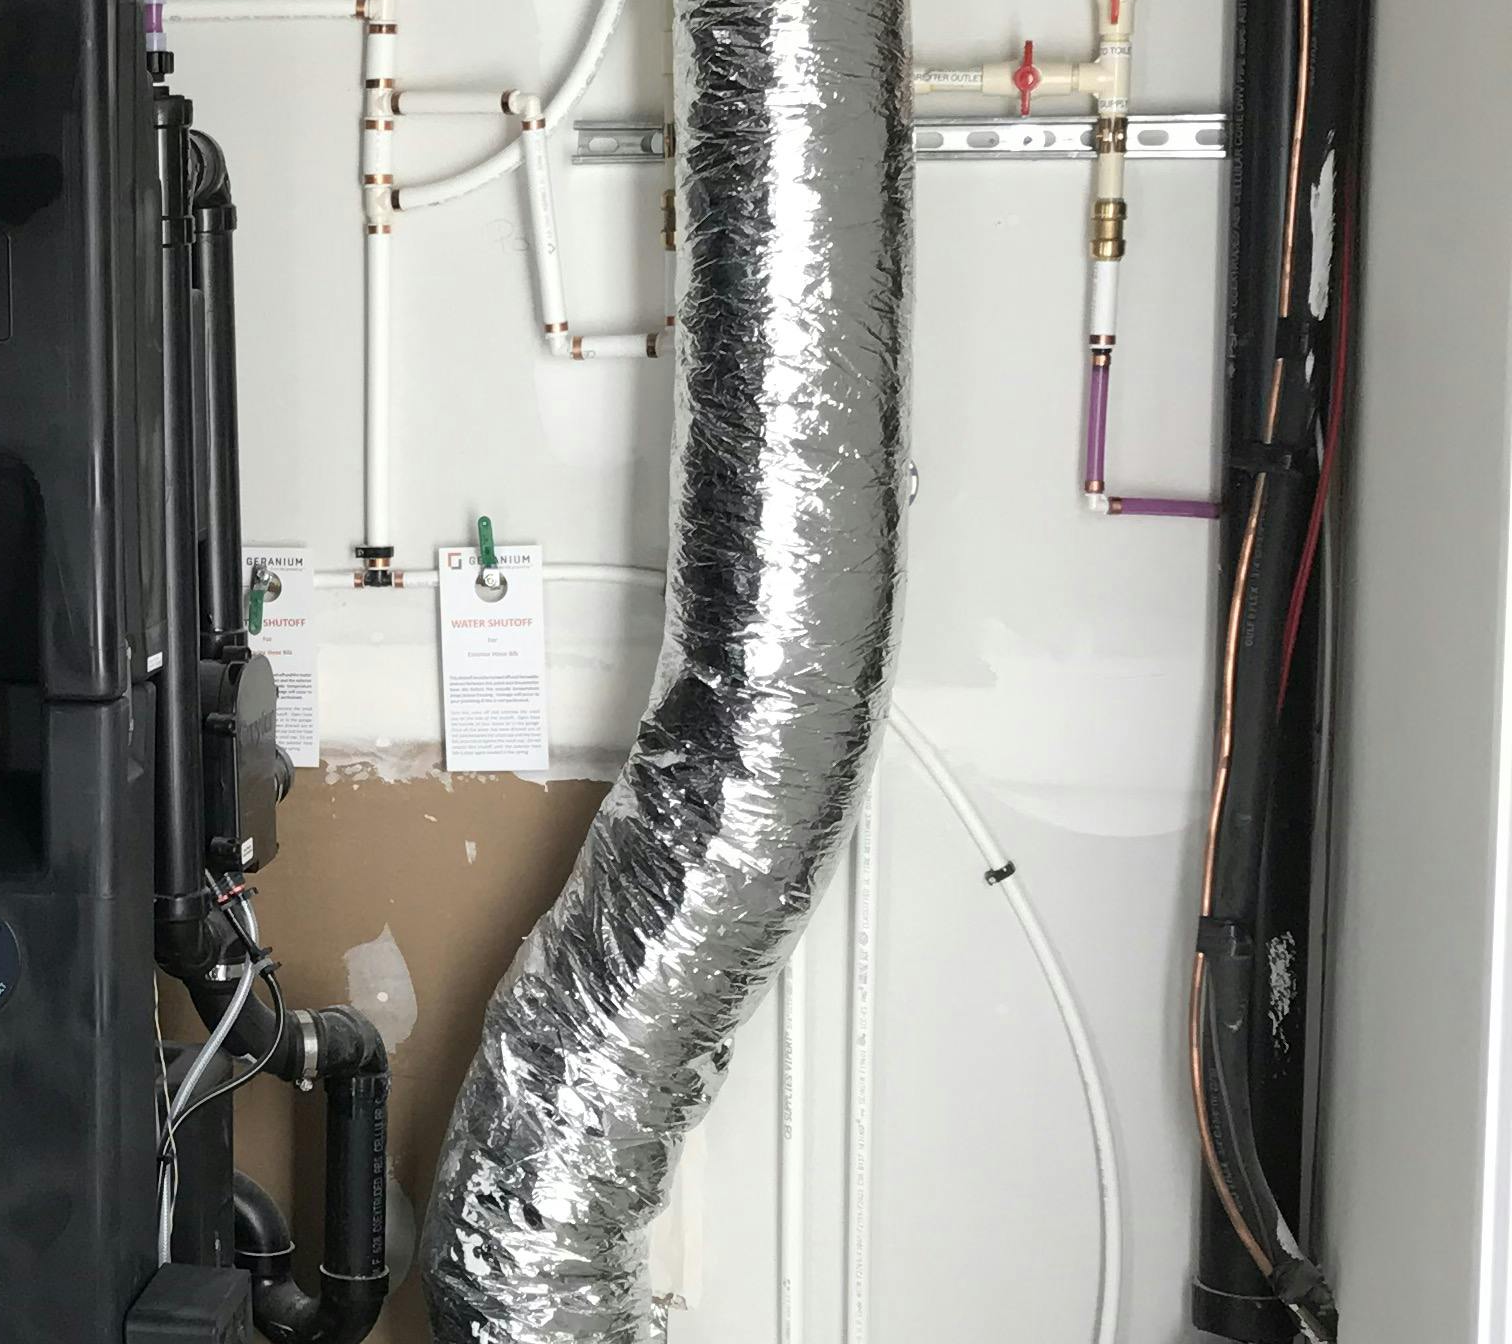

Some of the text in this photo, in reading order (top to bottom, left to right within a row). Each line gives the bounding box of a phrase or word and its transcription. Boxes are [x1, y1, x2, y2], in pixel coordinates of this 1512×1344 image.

[246, 557, 304, 567] GERANIUM
[263, 618, 307, 628] SHUTOFF
[451, 618, 533, 629] WATER SHUTOFF
[373, 1108, 385, 1153] CELLULAR
